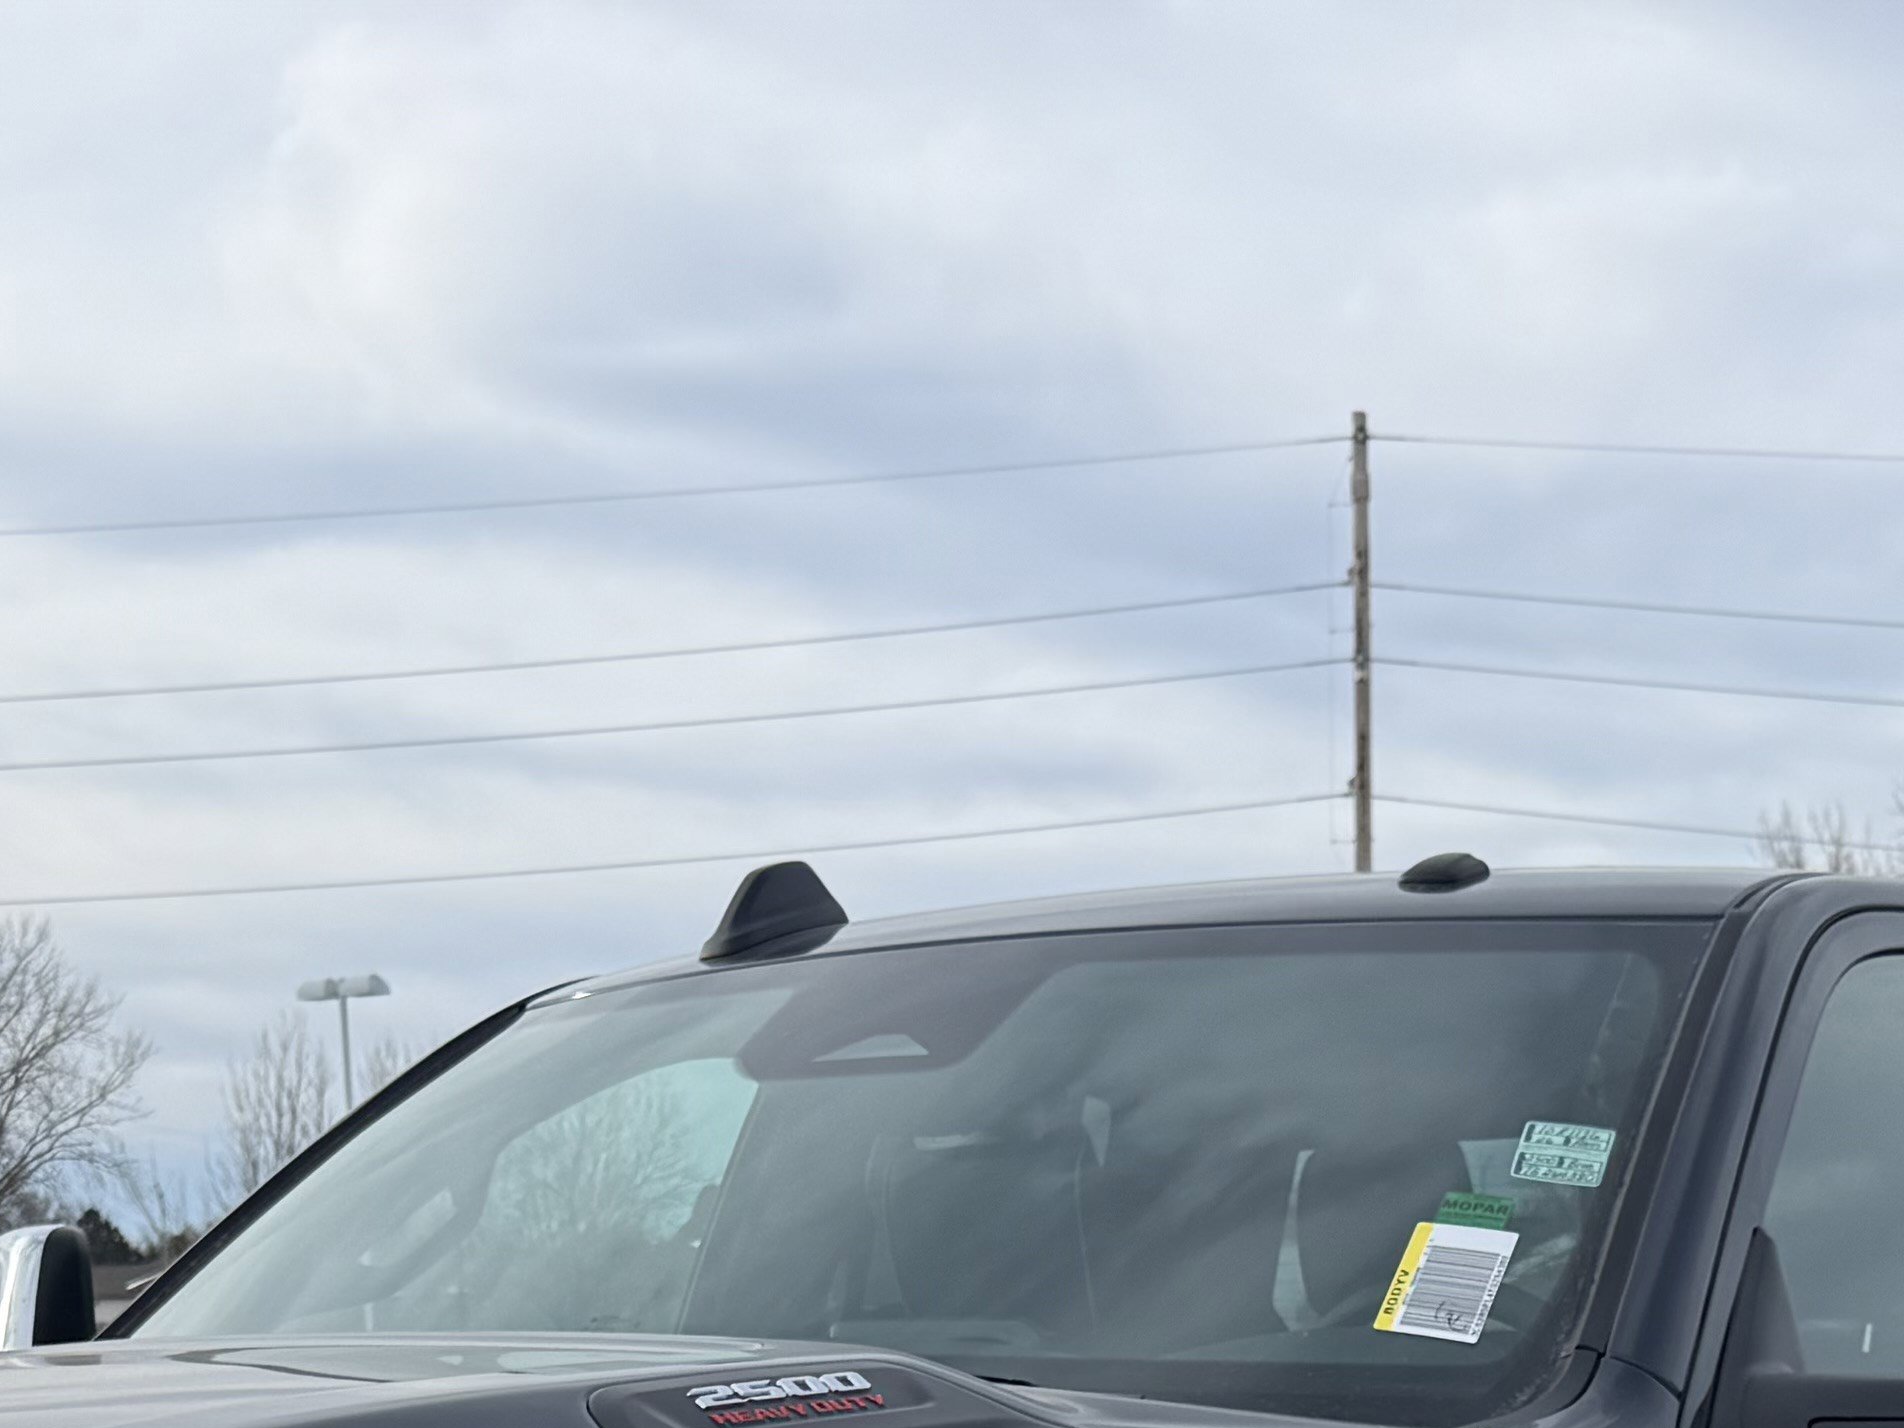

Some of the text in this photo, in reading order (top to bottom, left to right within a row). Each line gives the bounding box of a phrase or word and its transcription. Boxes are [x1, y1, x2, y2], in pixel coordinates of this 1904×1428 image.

[1442, 1199, 1509, 1216] MOPAR
[686, 1371, 872, 1409] 2500
[707, 1393, 886, 1426] HEAVY DUTY
